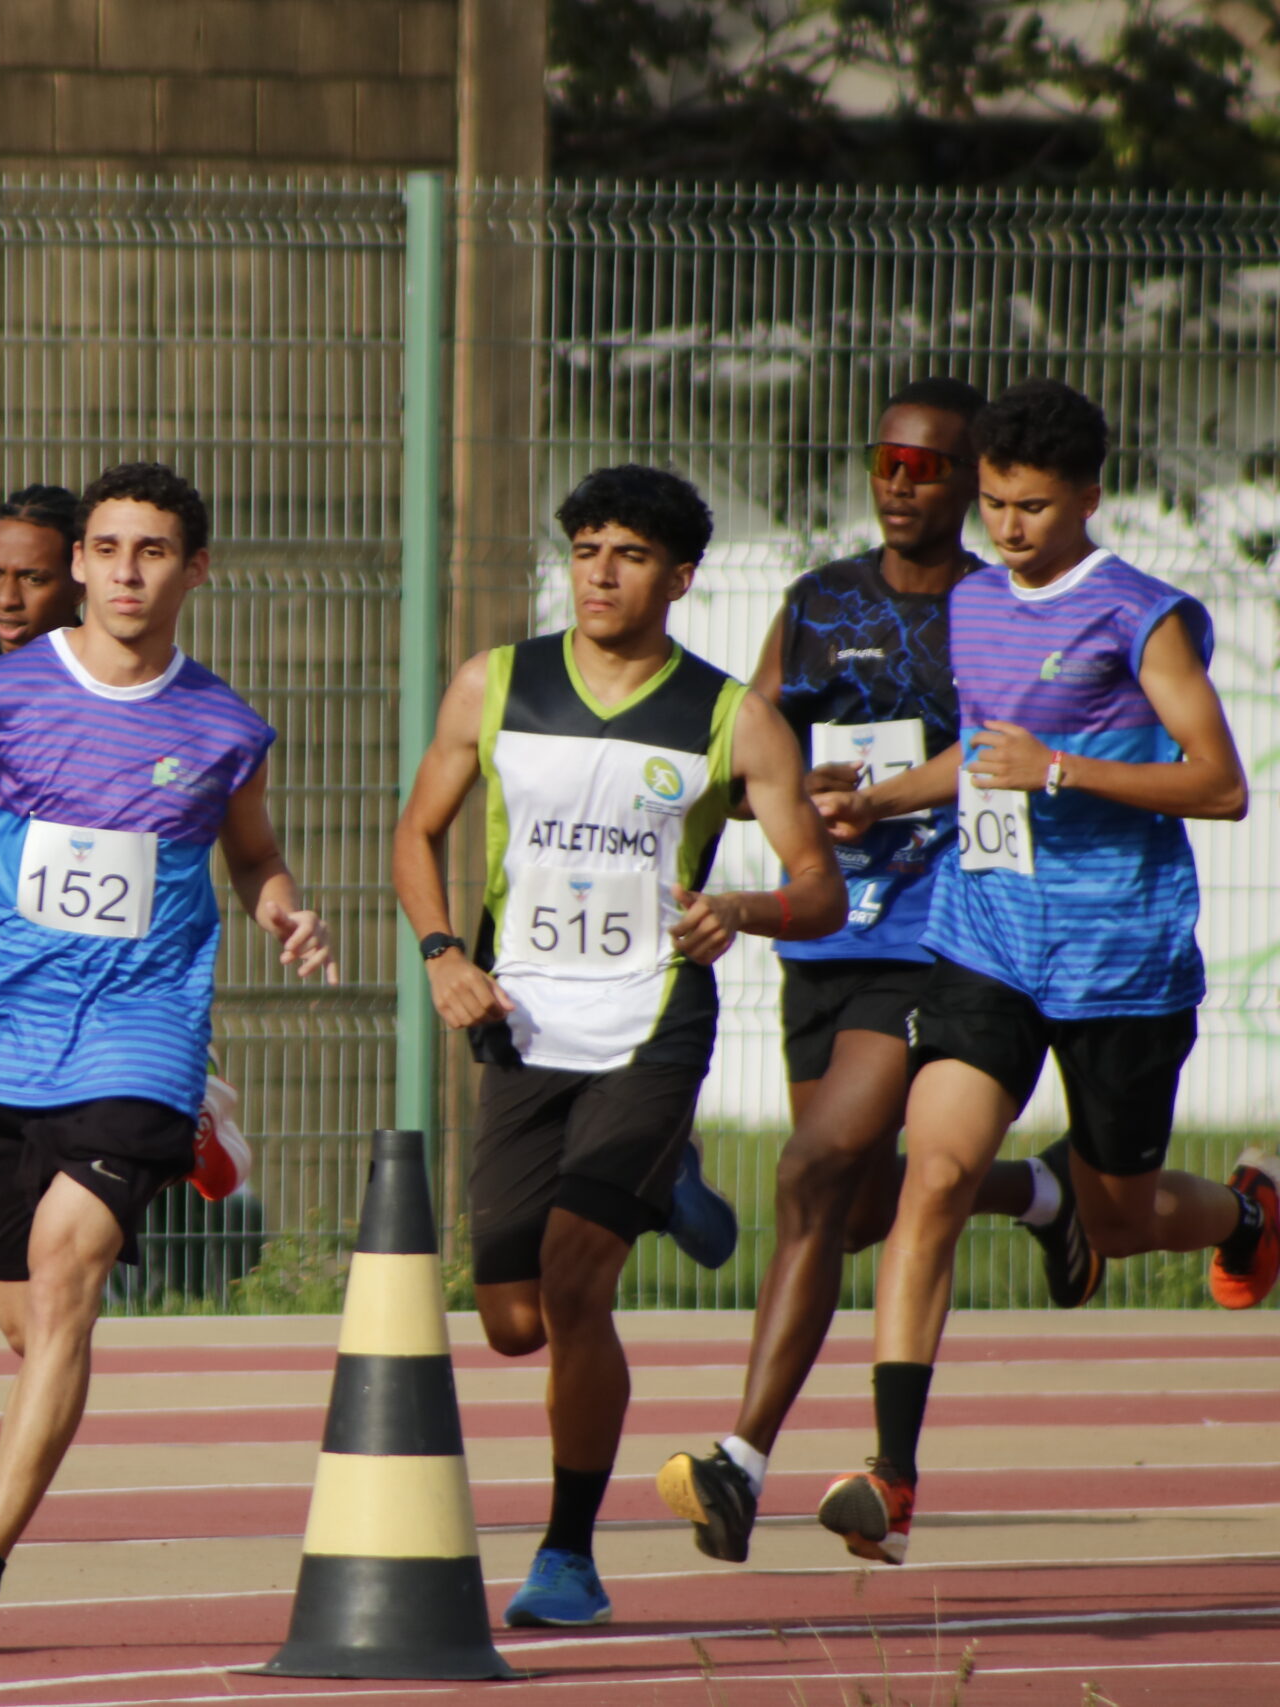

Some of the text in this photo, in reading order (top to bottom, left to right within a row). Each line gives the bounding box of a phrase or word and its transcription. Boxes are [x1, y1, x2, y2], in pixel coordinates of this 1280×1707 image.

[528, 820, 658, 857] ATLETISMO
[28, 865, 130, 922] 152
[529, 905, 632, 956] 515
